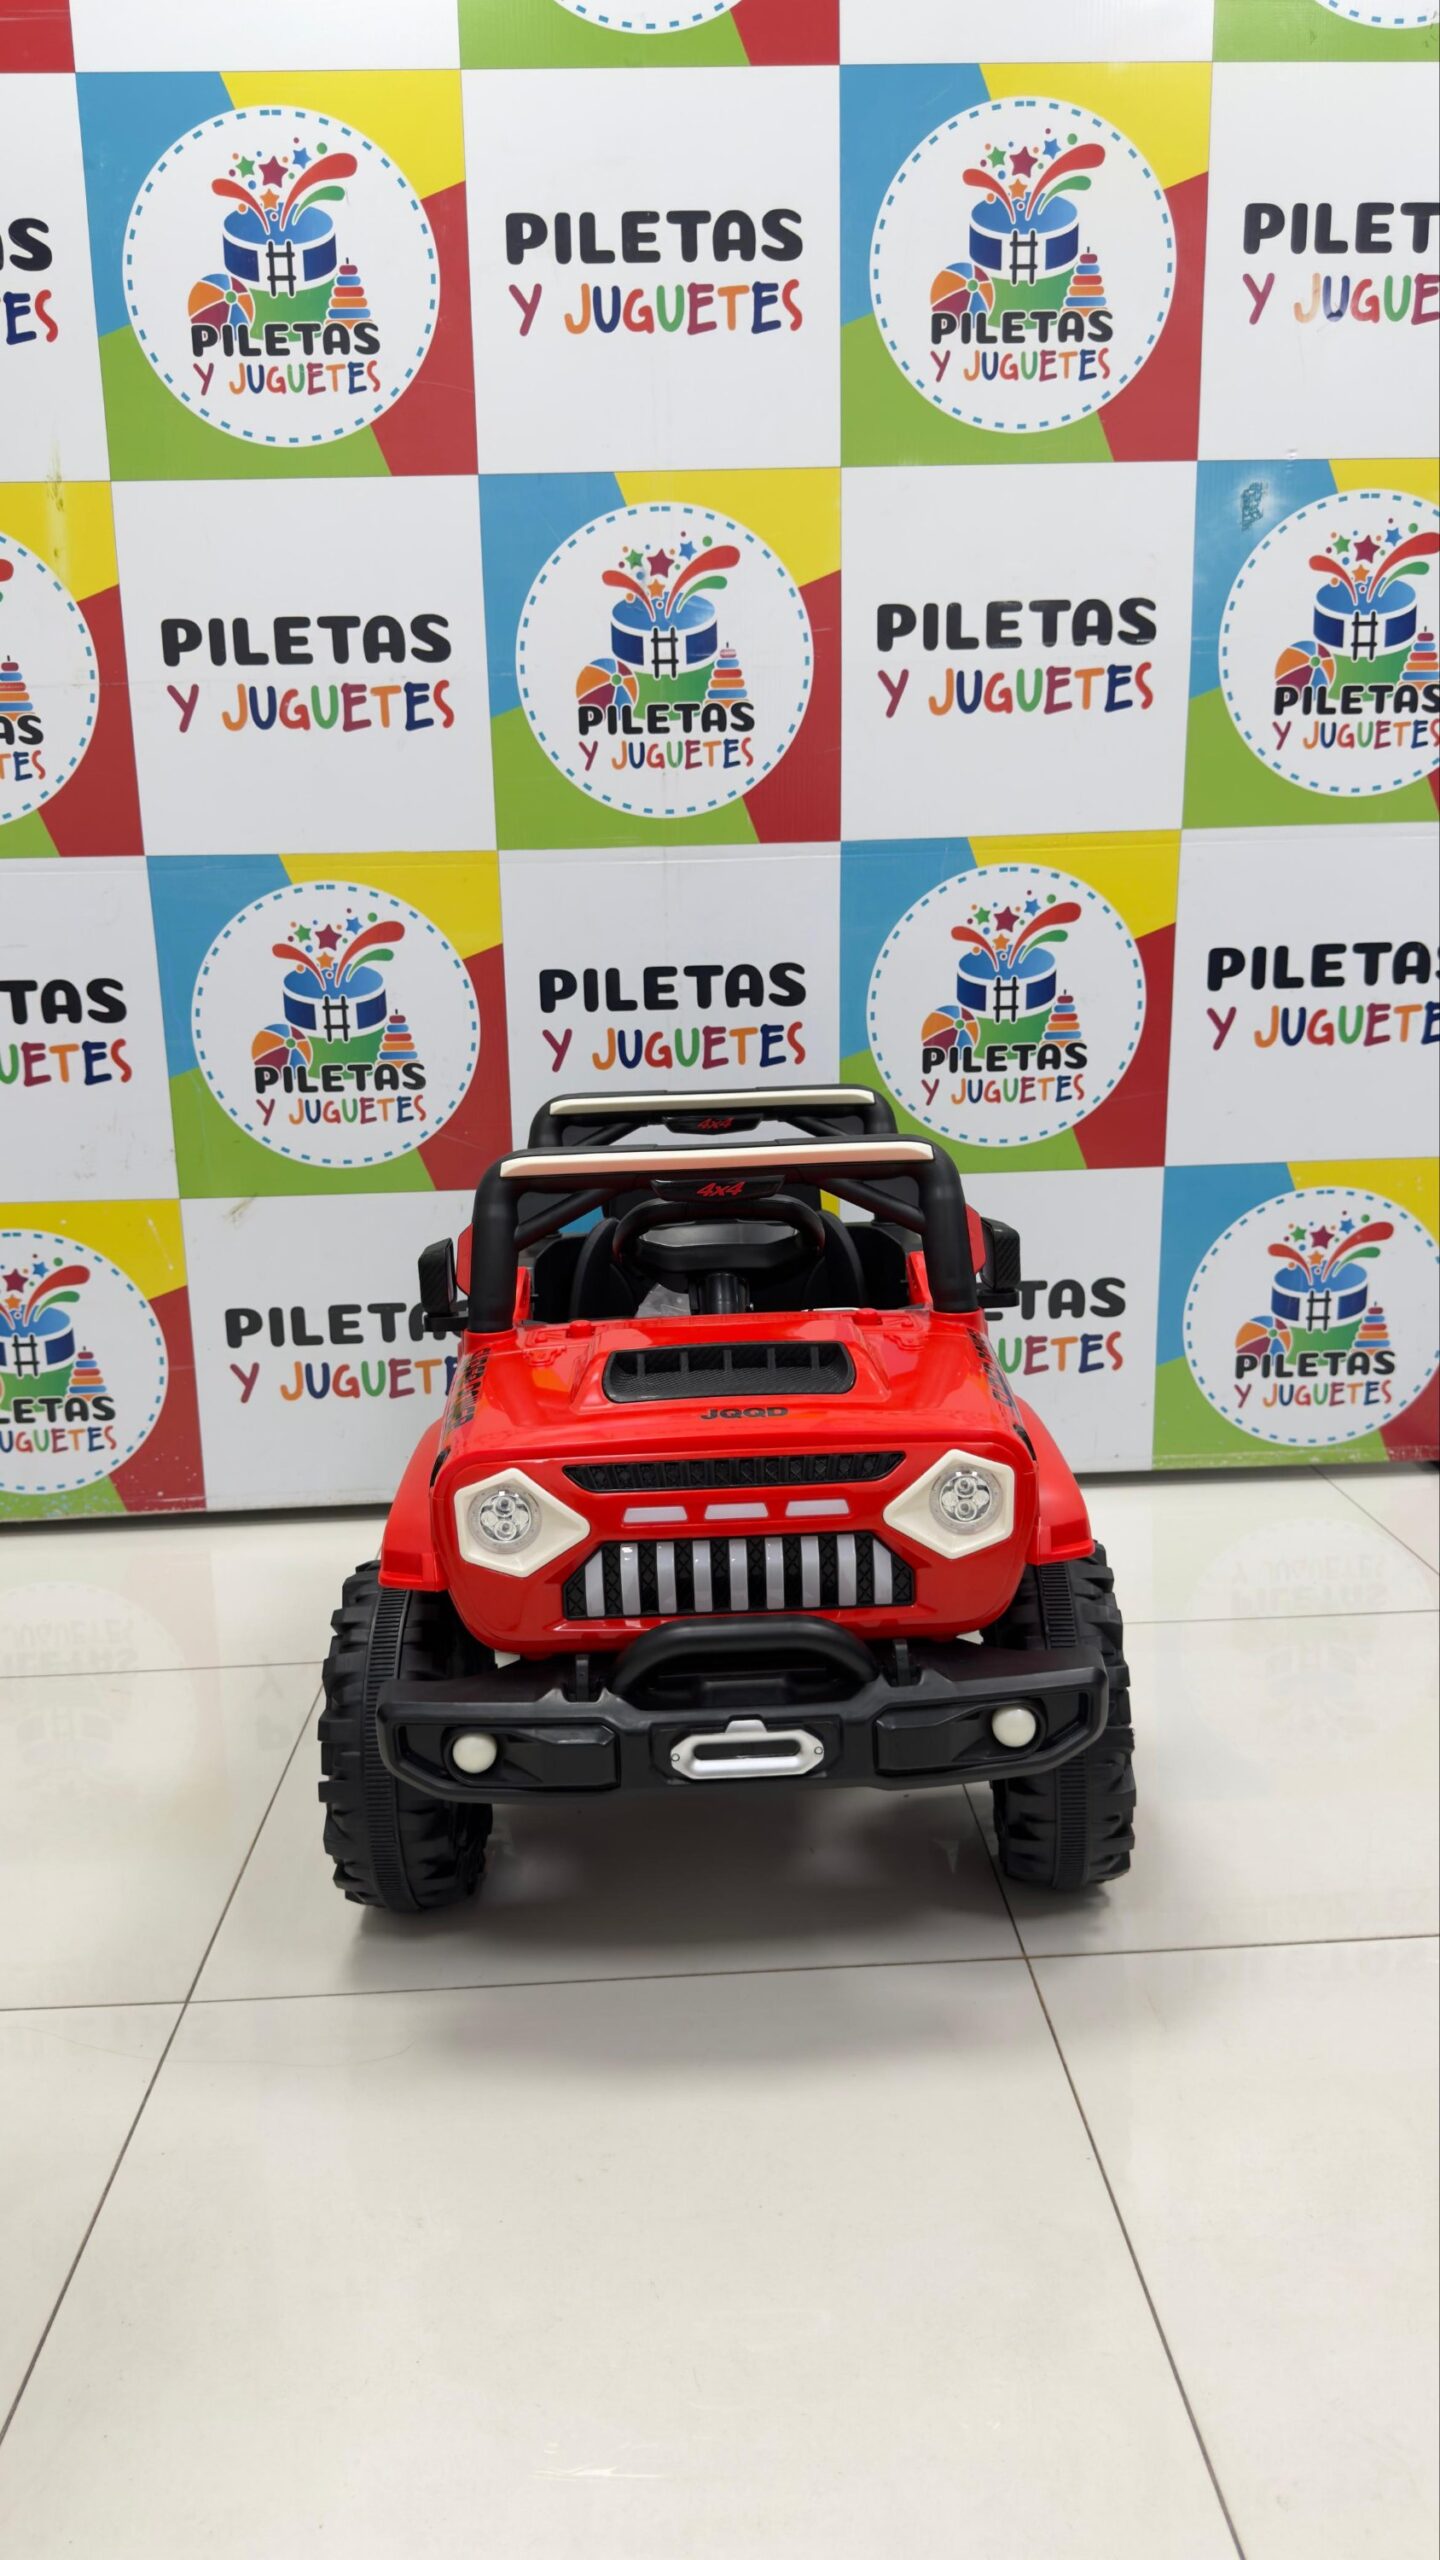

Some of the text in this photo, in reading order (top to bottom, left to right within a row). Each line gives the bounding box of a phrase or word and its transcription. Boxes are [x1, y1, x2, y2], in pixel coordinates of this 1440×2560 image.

[506, 209, 802, 264] PILETAS
[511, 279, 803, 335] Y JUGUETES
[1244, 275, 1273, 322] Y
[192, 323, 379, 356] PILETAS
[932, 311, 1112, 344] PILETAS
[192, 360, 380, 397] Y JUGUETES
[930, 347, 1111, 383] Y JUGUETES
[162, 614, 450, 666] PILETAS
[878, 598, 1156, 651] PILETAS
[168, 679, 454, 732] Y JUGUETES
[879, 662, 1153, 716] Y JUGUETES
[579, 702, 754, 735] PILETAS
[1272, 721, 1291, 750] Y
[578, 738, 755, 771] Y JUGUETES
[1208, 942, 1439, 991] PILETA
[540, 963, 806, 1013] PILETAS
[543, 1022, 805, 1071] Y JUGUETES
[1208, 1008, 1236, 1049] Y
[923, 1041, 1087, 1073] PILETAS
[255, 1063, 425, 1093] PILETAS
[921, 1074, 1085, 1106] Y JUGUETES
[256, 1095, 427, 1126] Y JUGUETES
[697, 1116, 735, 1130] 4x4
[696, 1180, 747, 1198] 4x4
[1236, 1351, 1394, 1378] PILETAS
[231, 1364, 258, 1402] Y
[1234, 1380, 1392, 1408] Y JUGUETES
